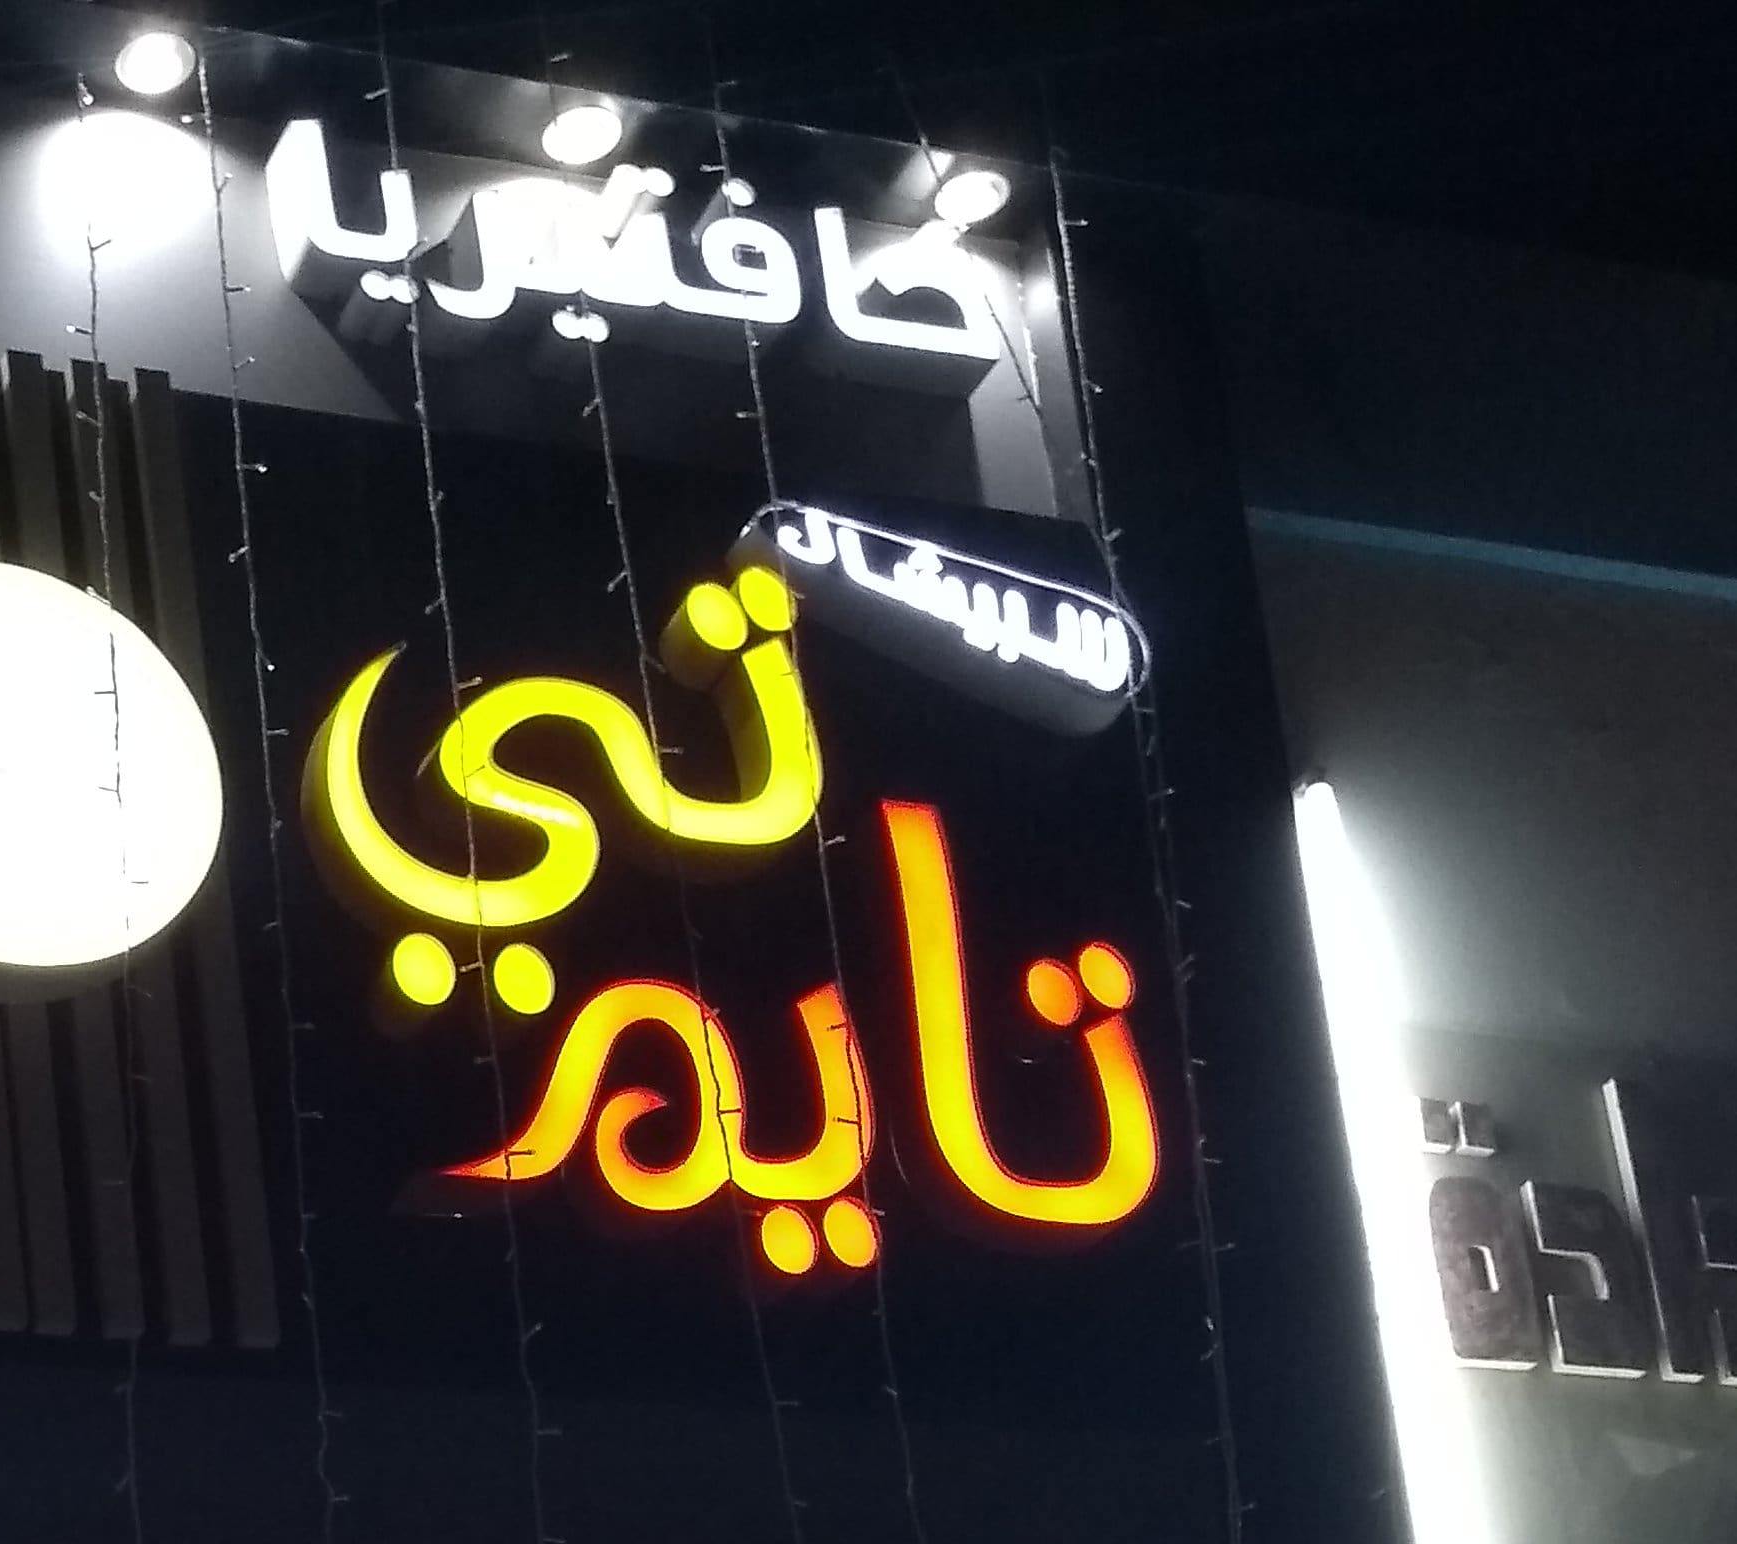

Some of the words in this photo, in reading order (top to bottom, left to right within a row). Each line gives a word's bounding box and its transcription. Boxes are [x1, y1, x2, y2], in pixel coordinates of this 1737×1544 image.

[321, 563, 825, 1016] تي
[776, 507, 1131, 692] سبيشال
[439, 800, 1161, 1278] تايم
